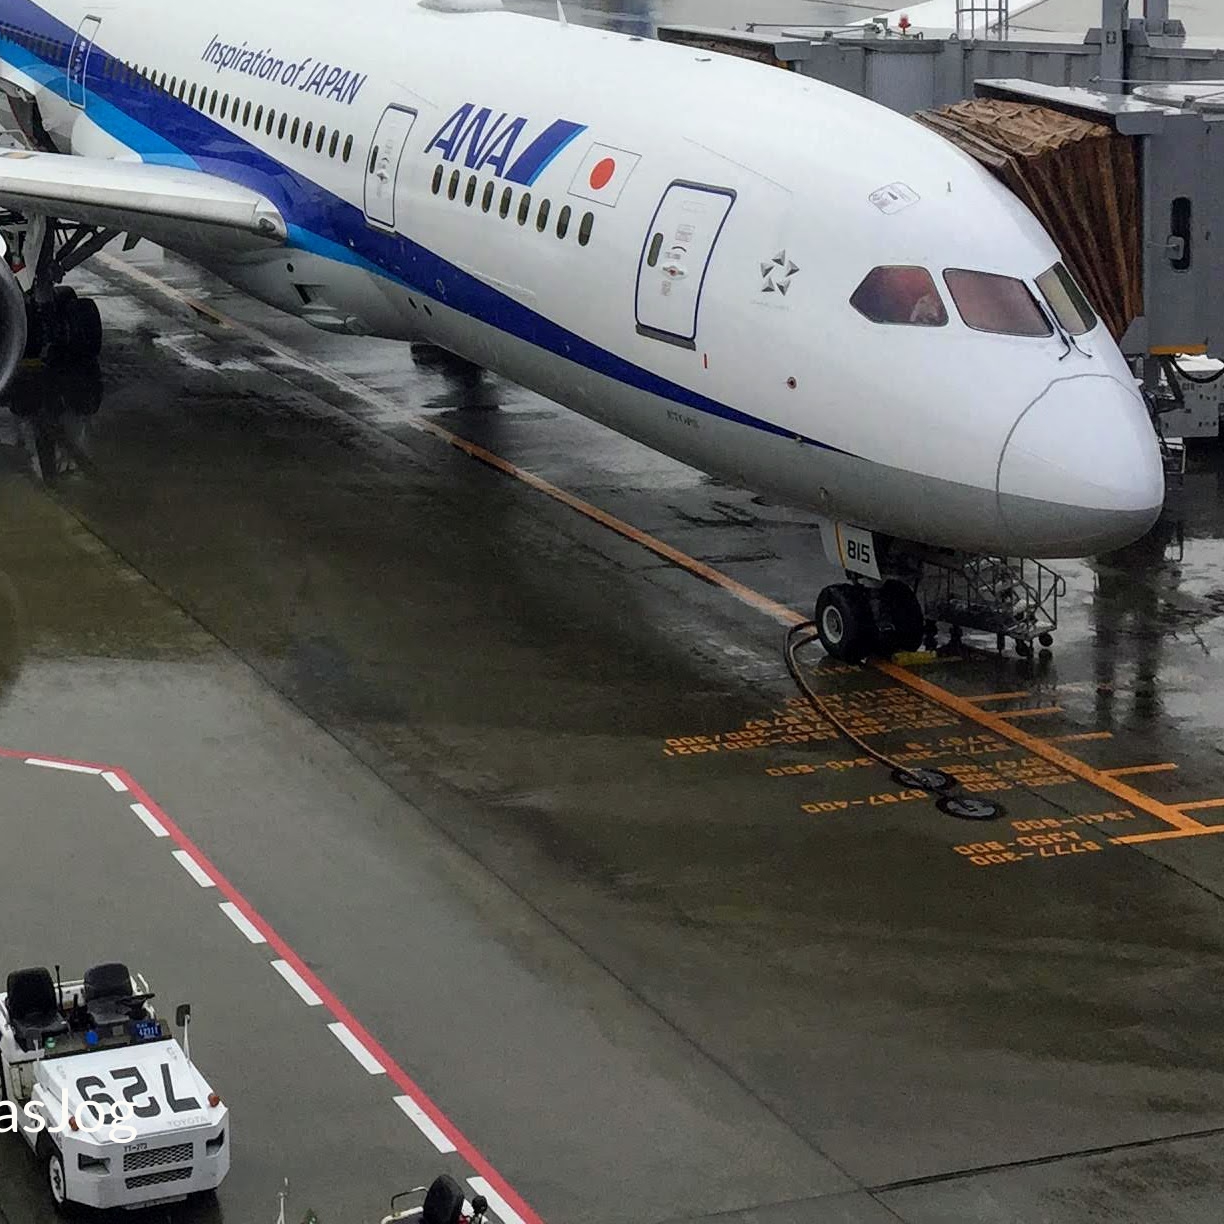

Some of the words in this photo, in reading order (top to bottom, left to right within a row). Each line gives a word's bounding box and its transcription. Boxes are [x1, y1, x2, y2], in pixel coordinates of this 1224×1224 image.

[201, 33, 284, 82] Inspiration
[281, 57, 312, 87] of
[298, 62, 368, 105] JAPAN
[424, 102, 528, 178] ANA
[847, 540, 870, 564] 815
[76, 1063, 201, 1124] 729
[168, 1116, 208, 1128] TOYOTA
